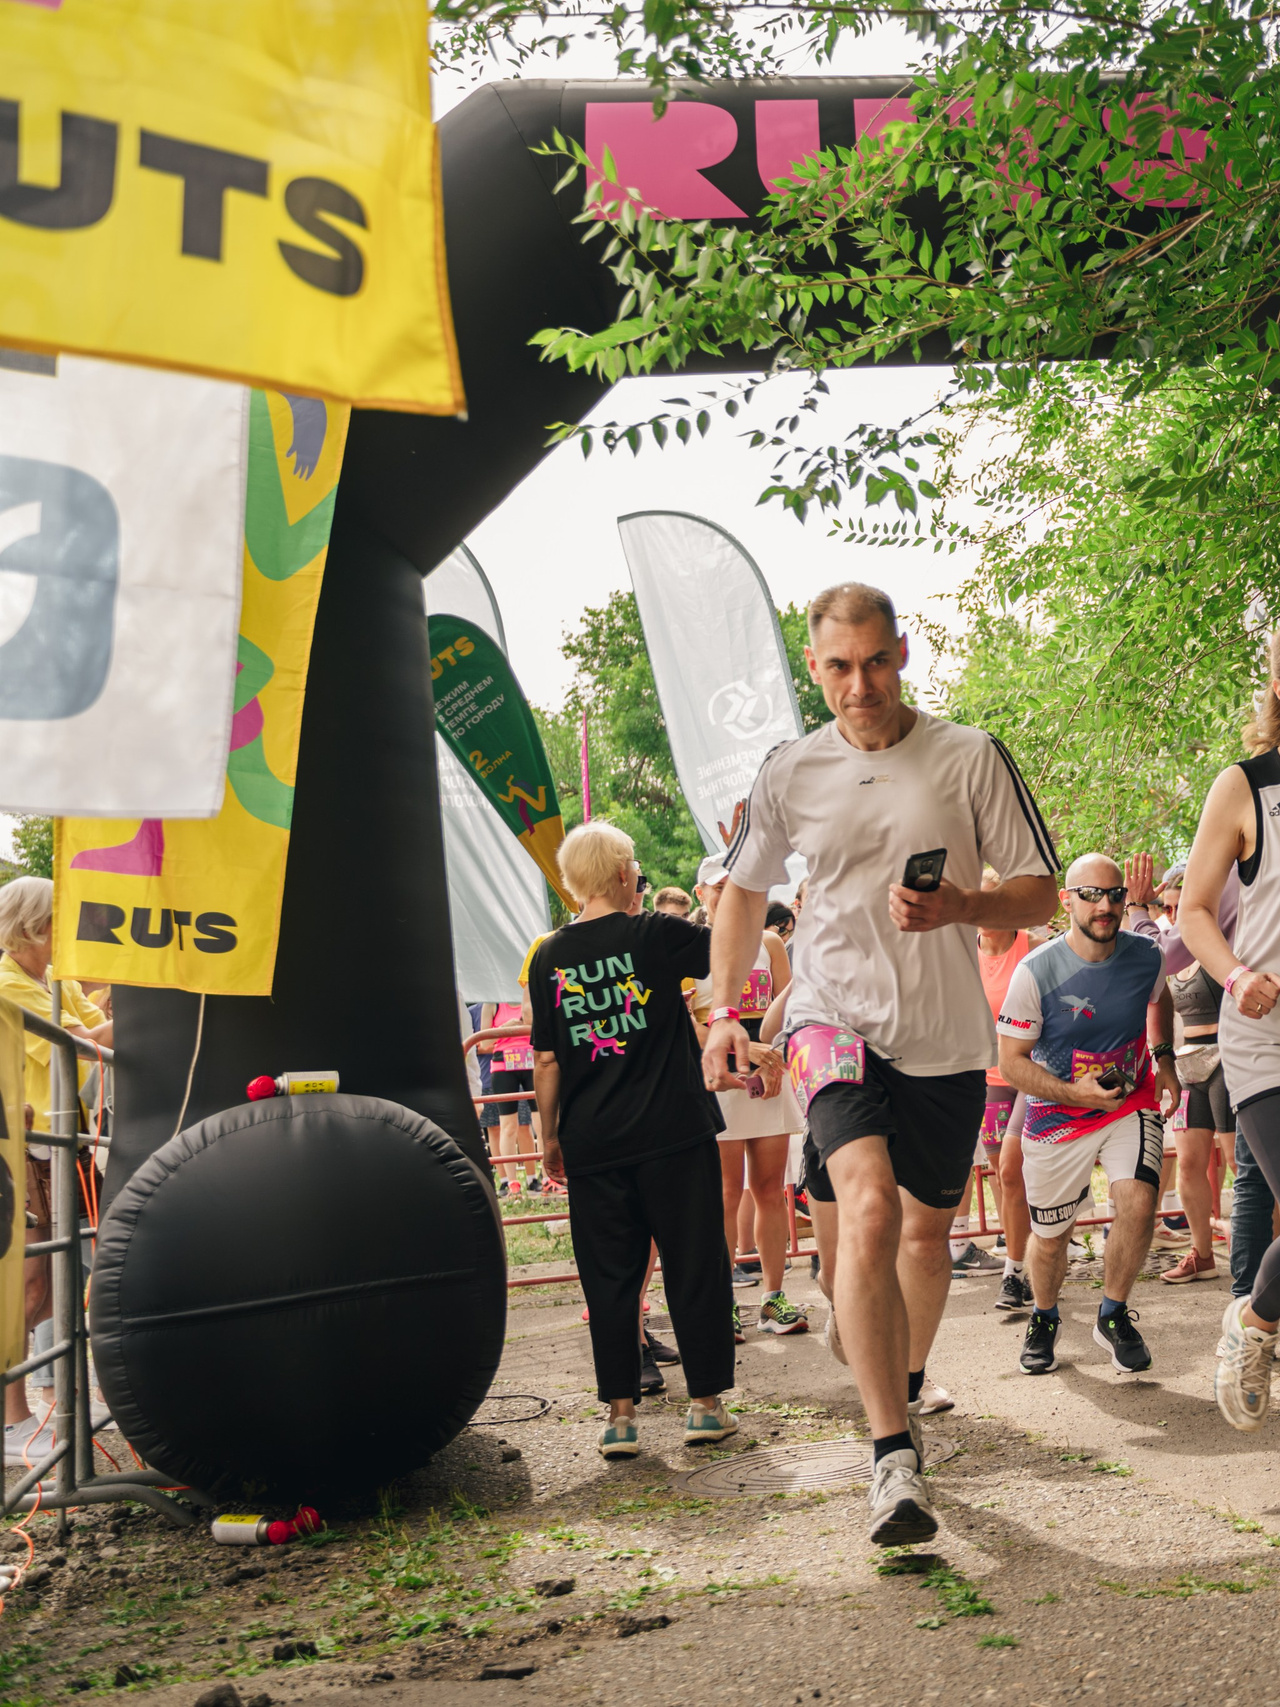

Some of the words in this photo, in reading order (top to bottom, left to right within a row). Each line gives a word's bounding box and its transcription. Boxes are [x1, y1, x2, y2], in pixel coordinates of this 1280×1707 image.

[445, 675, 494, 716] СРЕДНЕМ
[445, 702, 479, 731] ТЕМПЕ
[451, 727, 466, 741] ПО
[465, 693, 505, 729] ГОРОДУ
[469, 750, 488, 771] 2
[480, 750, 513, 779] ВОЛНА
[76, 901, 237, 954] RUTS
[557, 952, 635, 991] RUN
[562, 985, 640, 1019] RUN
[569, 1008, 648, 1047] RUN
[1036, 1209, 1059, 1223] BLACK
[1058, 1200, 1079, 1220] SQUA
